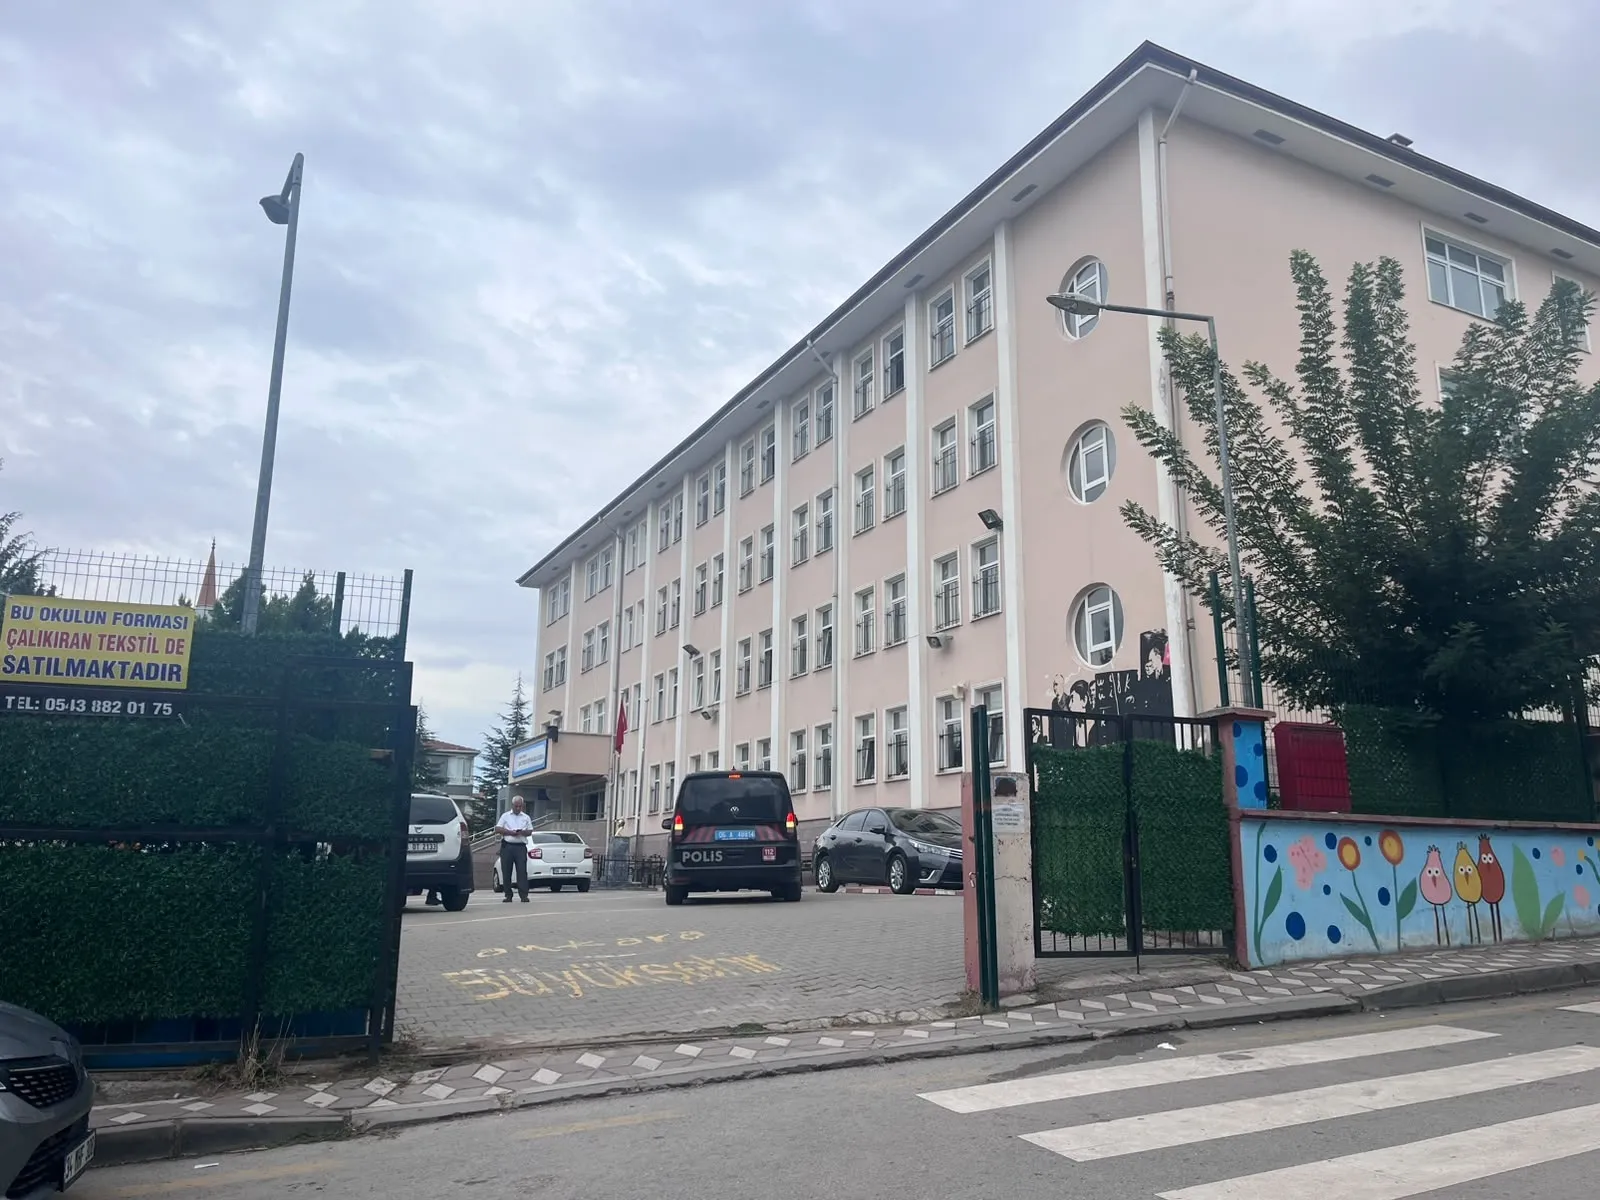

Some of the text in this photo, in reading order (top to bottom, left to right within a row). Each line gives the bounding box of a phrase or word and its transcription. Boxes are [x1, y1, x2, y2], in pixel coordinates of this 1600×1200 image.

[10, 604, 188, 630] BU OKULUN FORMASI
[6, 628, 186, 656] ÇALIKIRAN TEKSTİL DE
[2, 654, 183, 682] SATILMAKTADIR
[5, 695, 40, 711] TEL:
[91, 700, 121, 714] 882
[126, 701, 146, 715] 01
[152, 702, 173, 716] 75
[764, 848, 774, 856] 112
